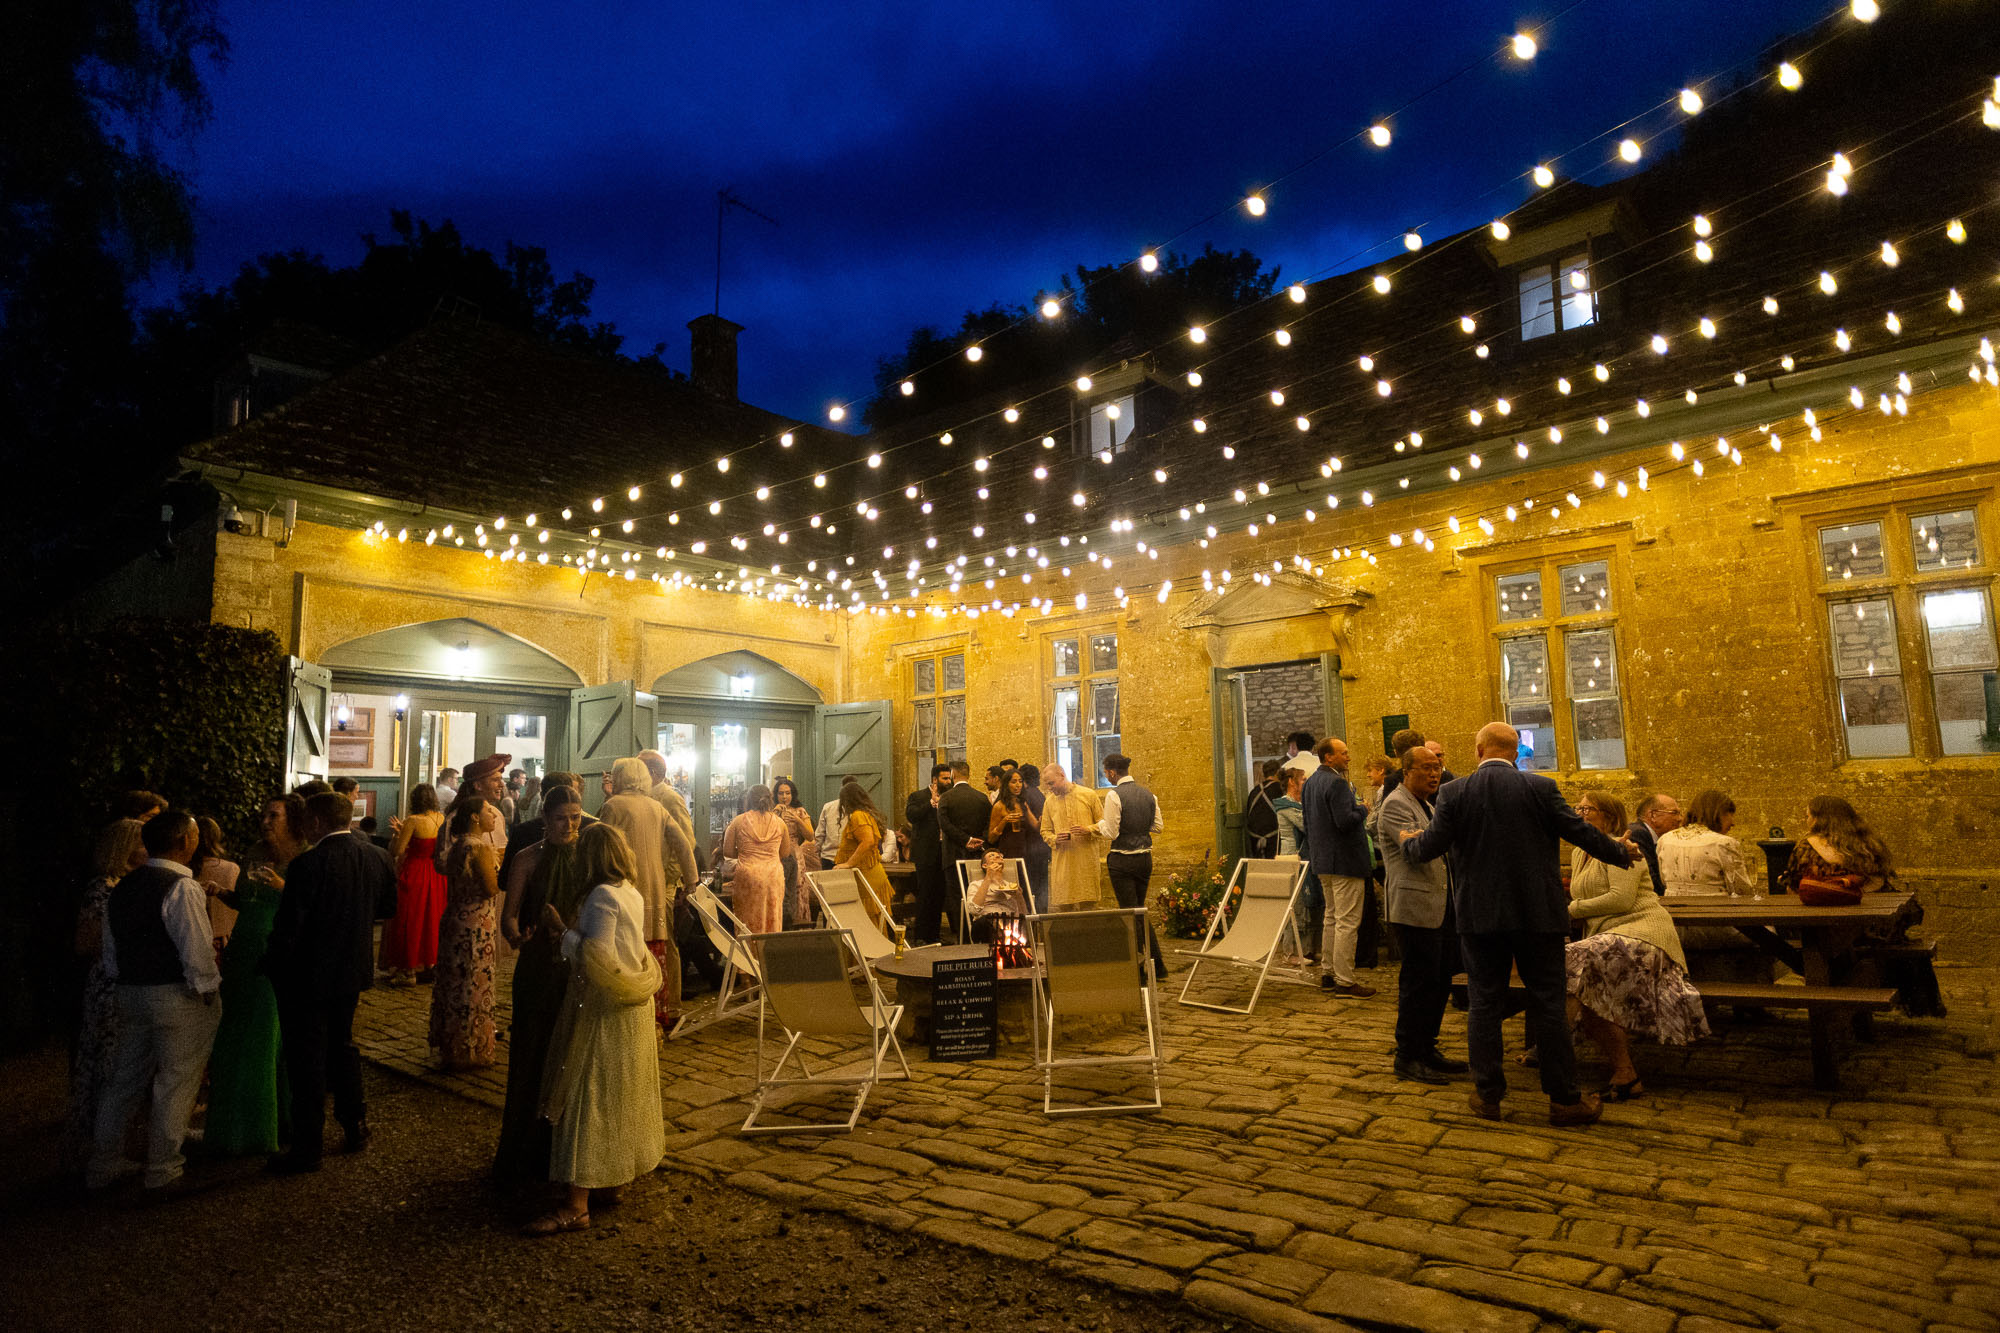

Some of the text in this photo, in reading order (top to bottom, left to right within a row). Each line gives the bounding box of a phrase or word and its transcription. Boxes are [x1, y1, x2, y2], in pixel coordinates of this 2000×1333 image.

[937, 960, 993, 972] FIRE PIT RULES
[954, 975, 976, 983] ROAST
[938, 981, 992, 990] MARSHMALLOWS
[965, 996, 993, 1004] UNWIND
